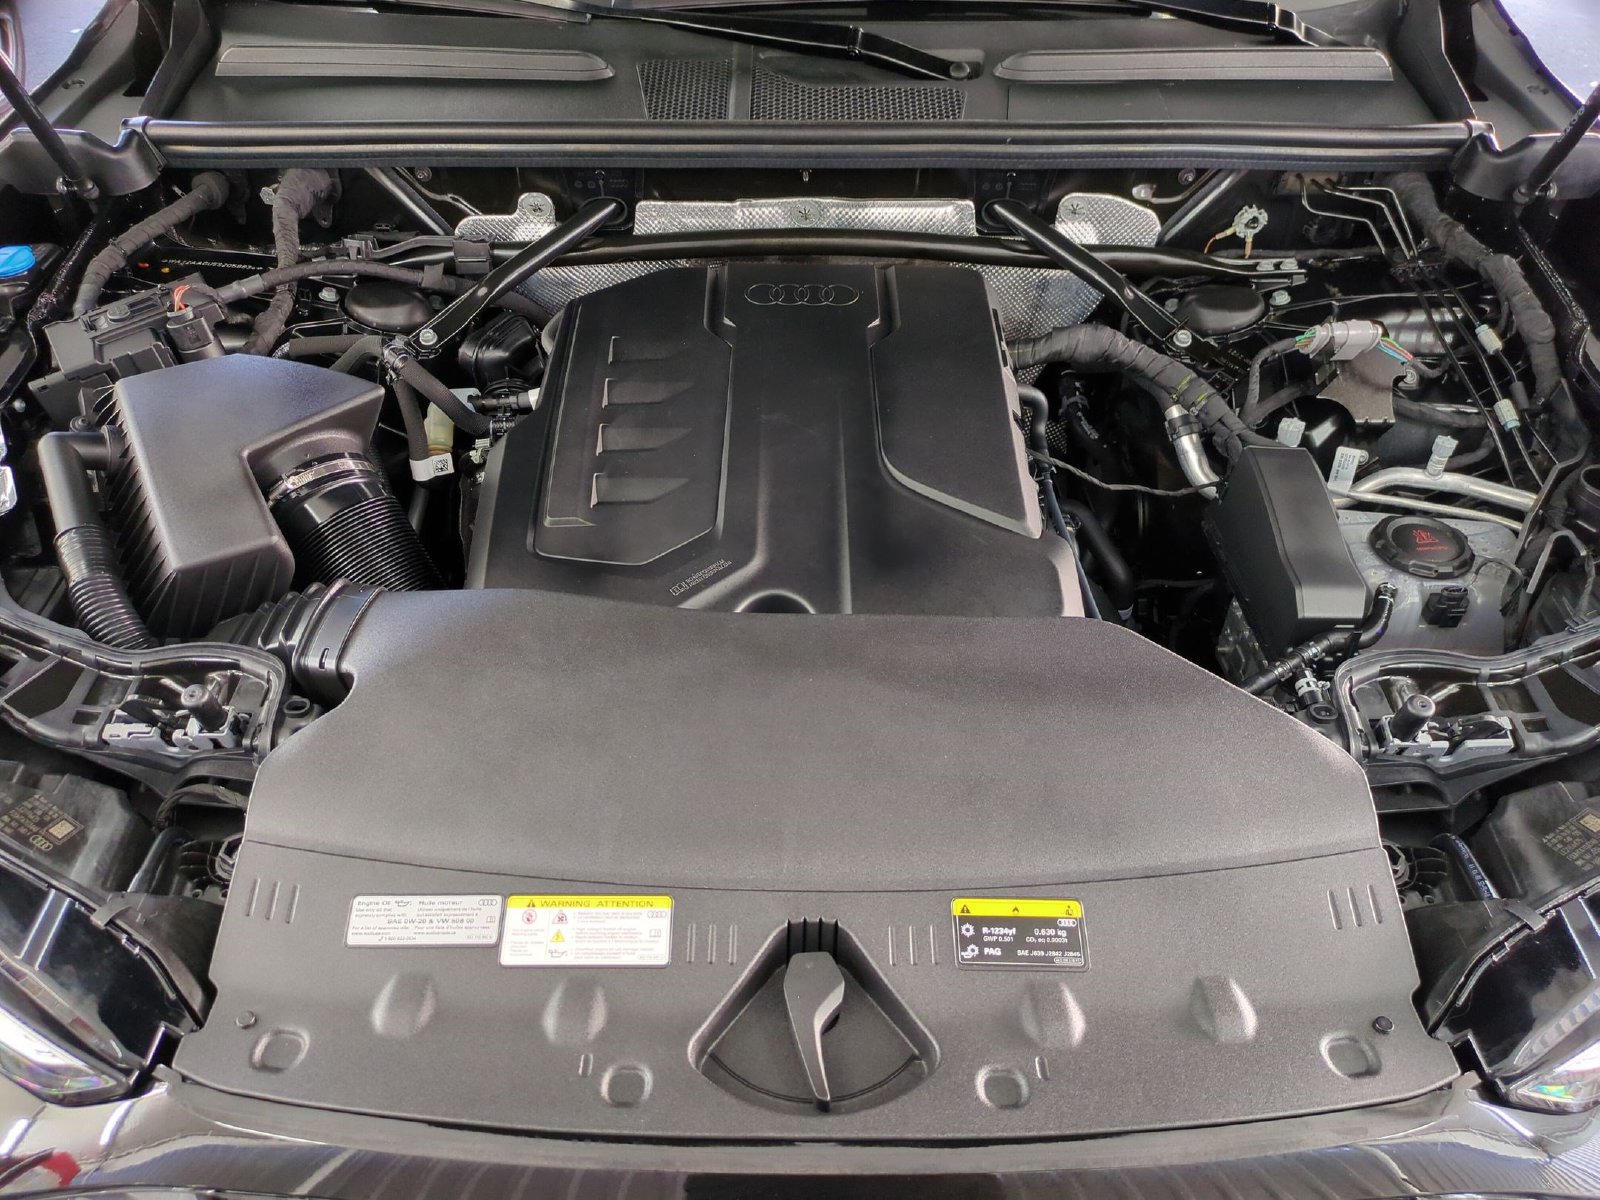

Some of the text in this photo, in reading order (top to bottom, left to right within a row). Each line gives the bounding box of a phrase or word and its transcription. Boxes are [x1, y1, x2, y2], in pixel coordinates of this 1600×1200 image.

[540, 900, 654, 908] WARNING ATTENTION
[982, 926, 1017, 936] R-1234yf
[1033, 928, 1068, 938] 0.630 kg
[983, 947, 1002, 956] PAG
